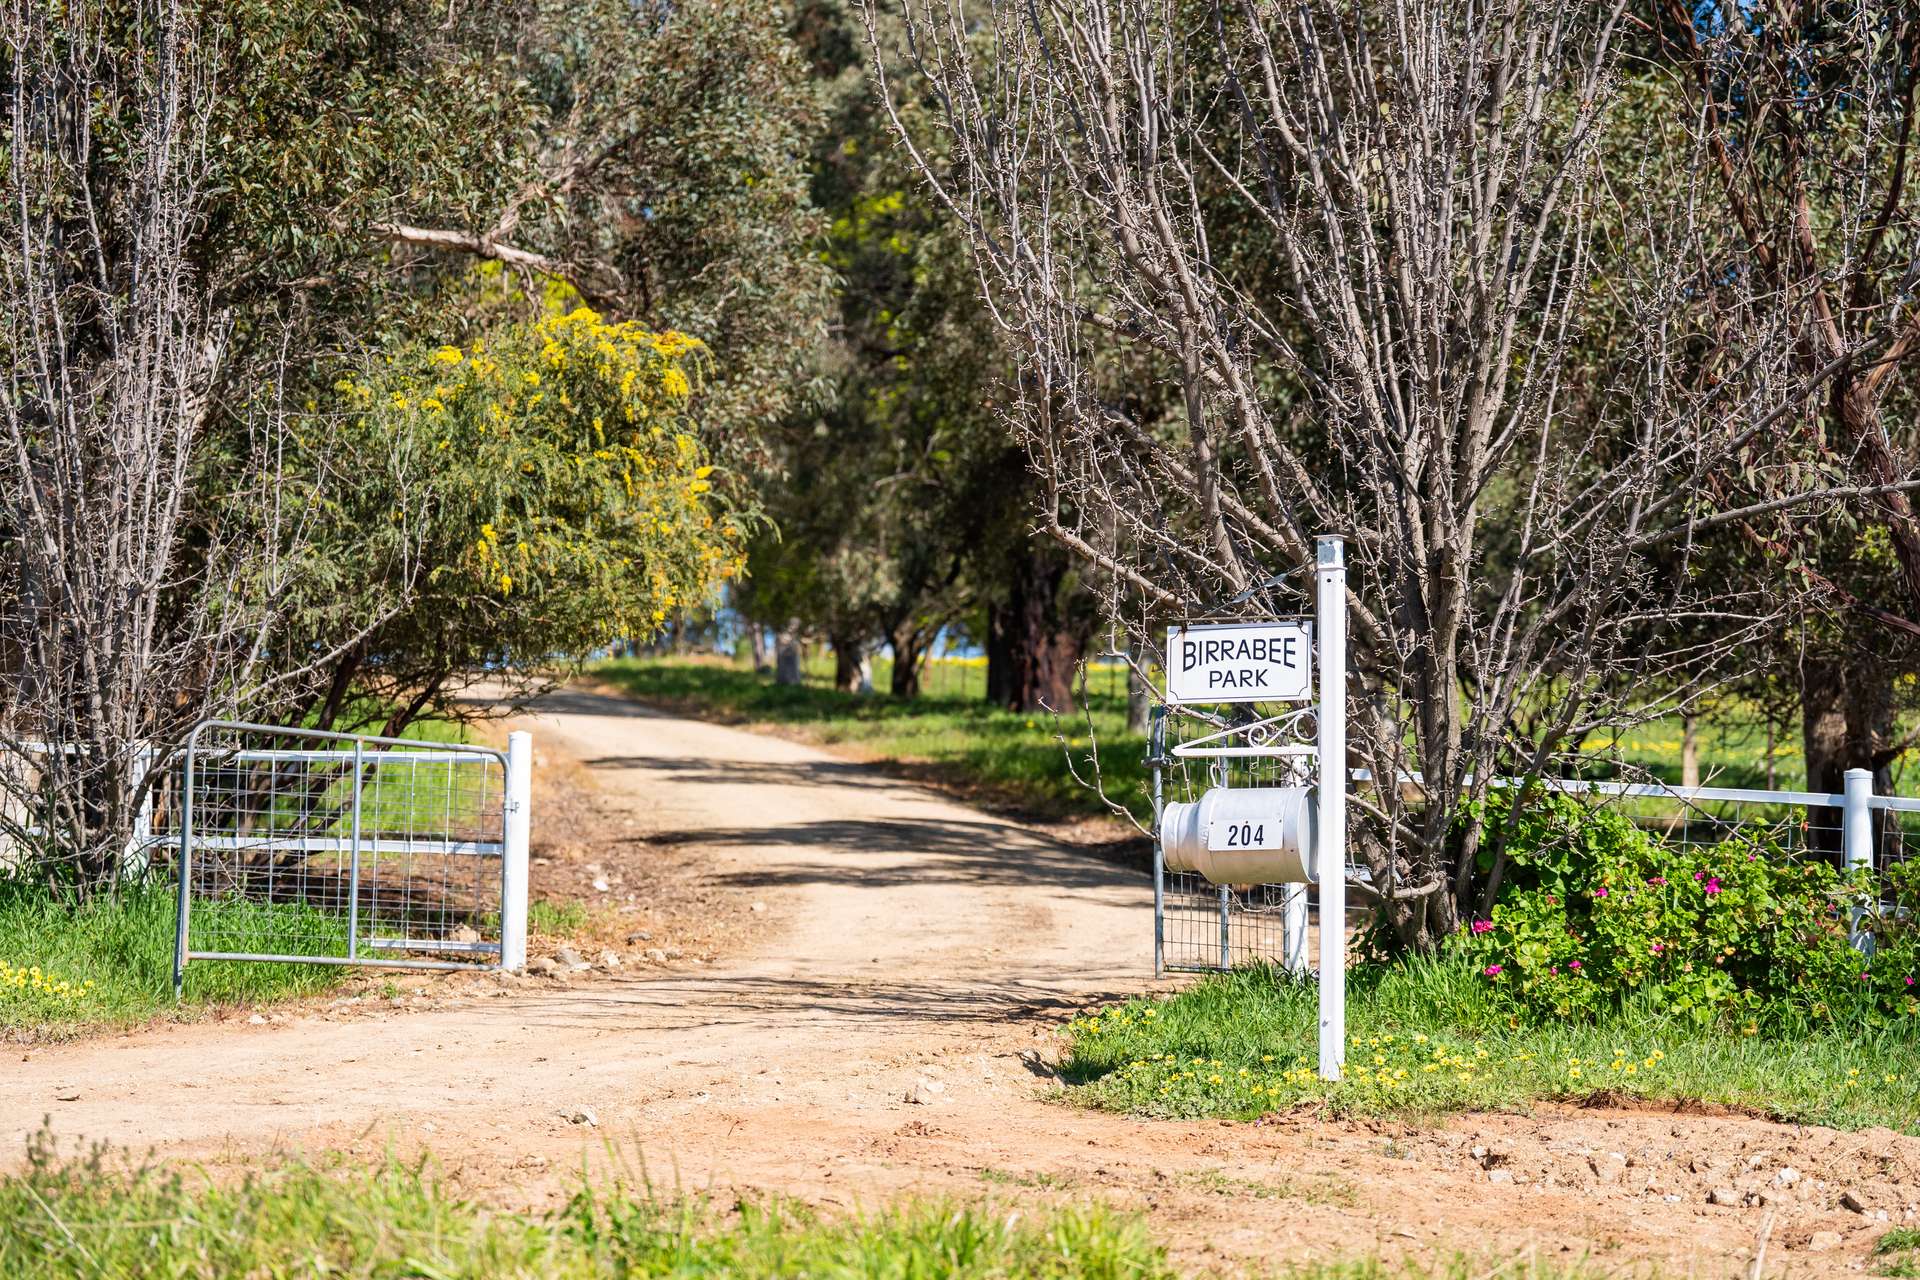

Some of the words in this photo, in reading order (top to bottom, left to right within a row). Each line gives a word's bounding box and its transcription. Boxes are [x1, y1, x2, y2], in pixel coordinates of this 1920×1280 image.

[1183, 637, 1296, 672] BIRRABEE
[1209, 669, 1268, 688] PARK
[1227, 824, 1264, 847] 204
